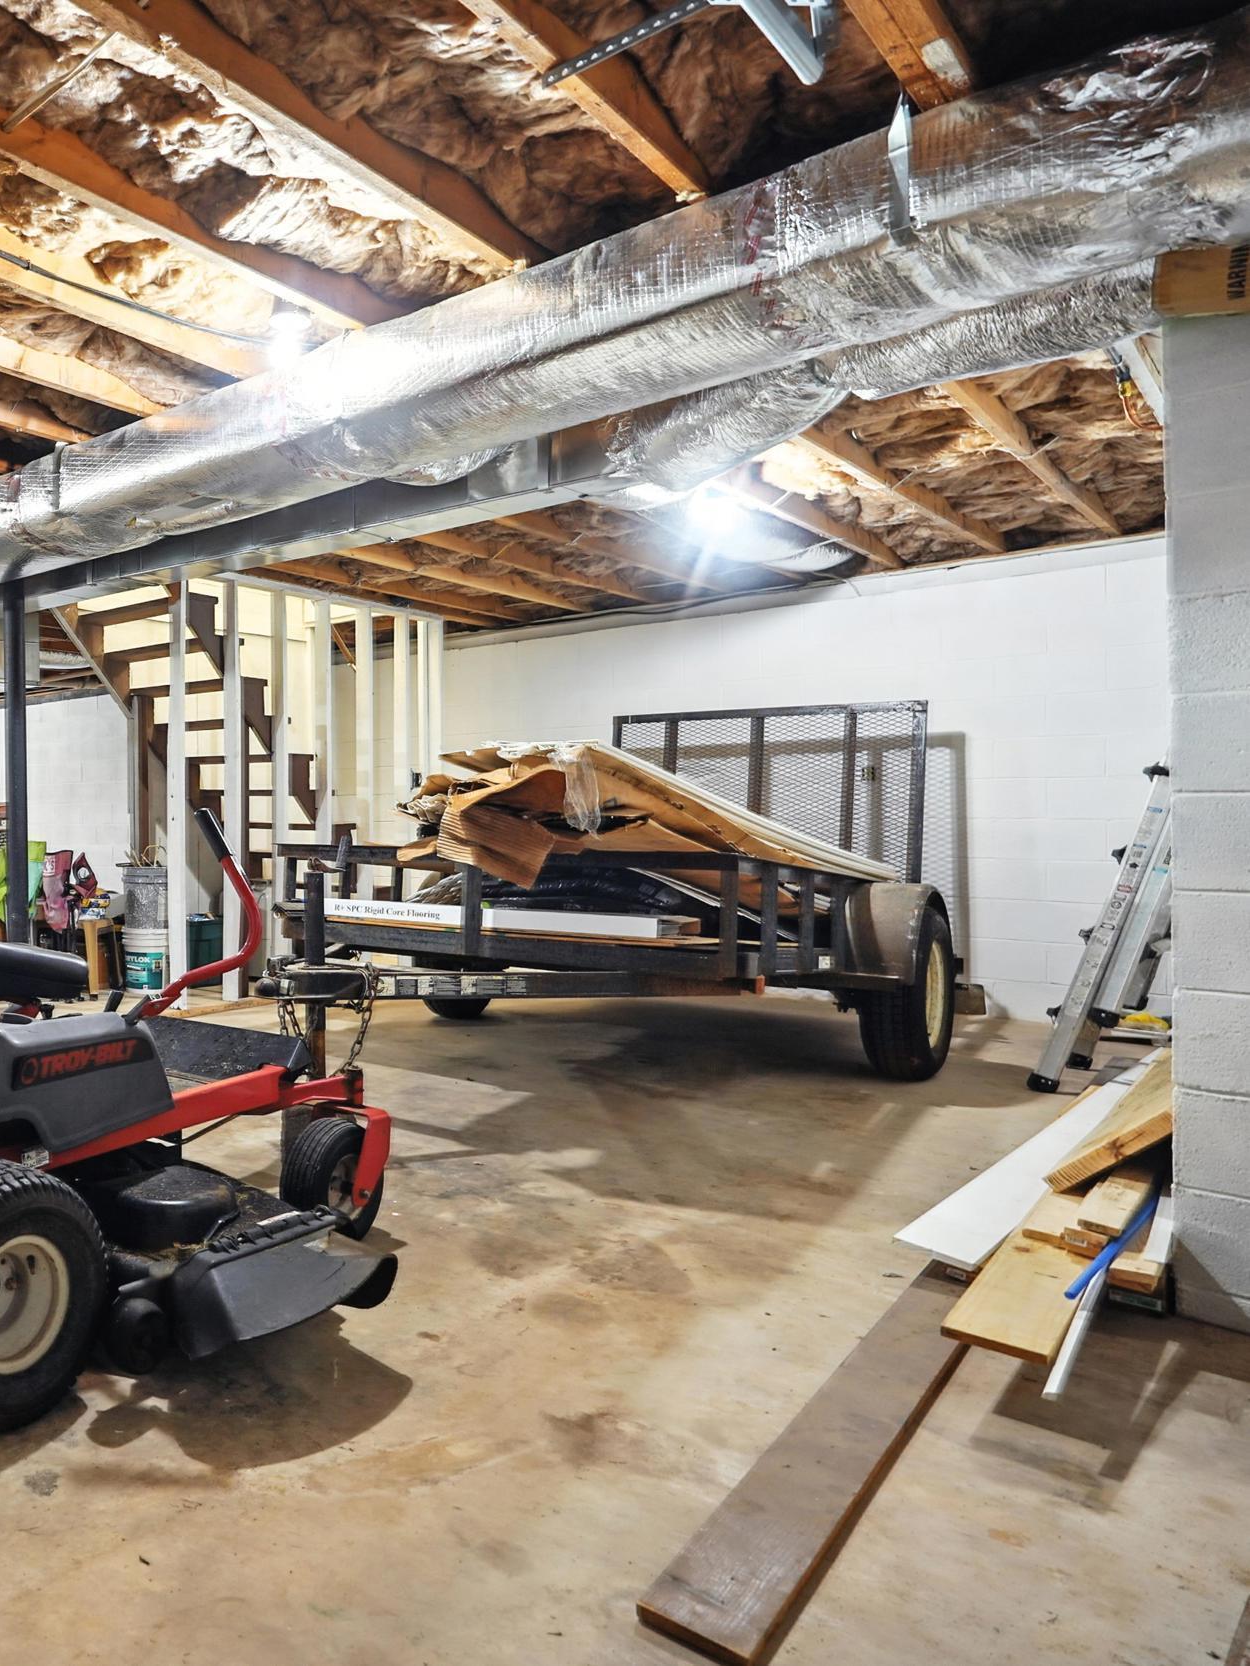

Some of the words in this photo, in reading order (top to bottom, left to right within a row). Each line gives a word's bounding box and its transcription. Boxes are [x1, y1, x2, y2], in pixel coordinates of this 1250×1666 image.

[346, 904, 363, 912] SPC
[364, 905, 384, 915] Rigid
[386, 907, 405, 916] Core
[406, 908, 441, 920] Flooring
[40, 1039, 138, 1078] TROY-BILT
